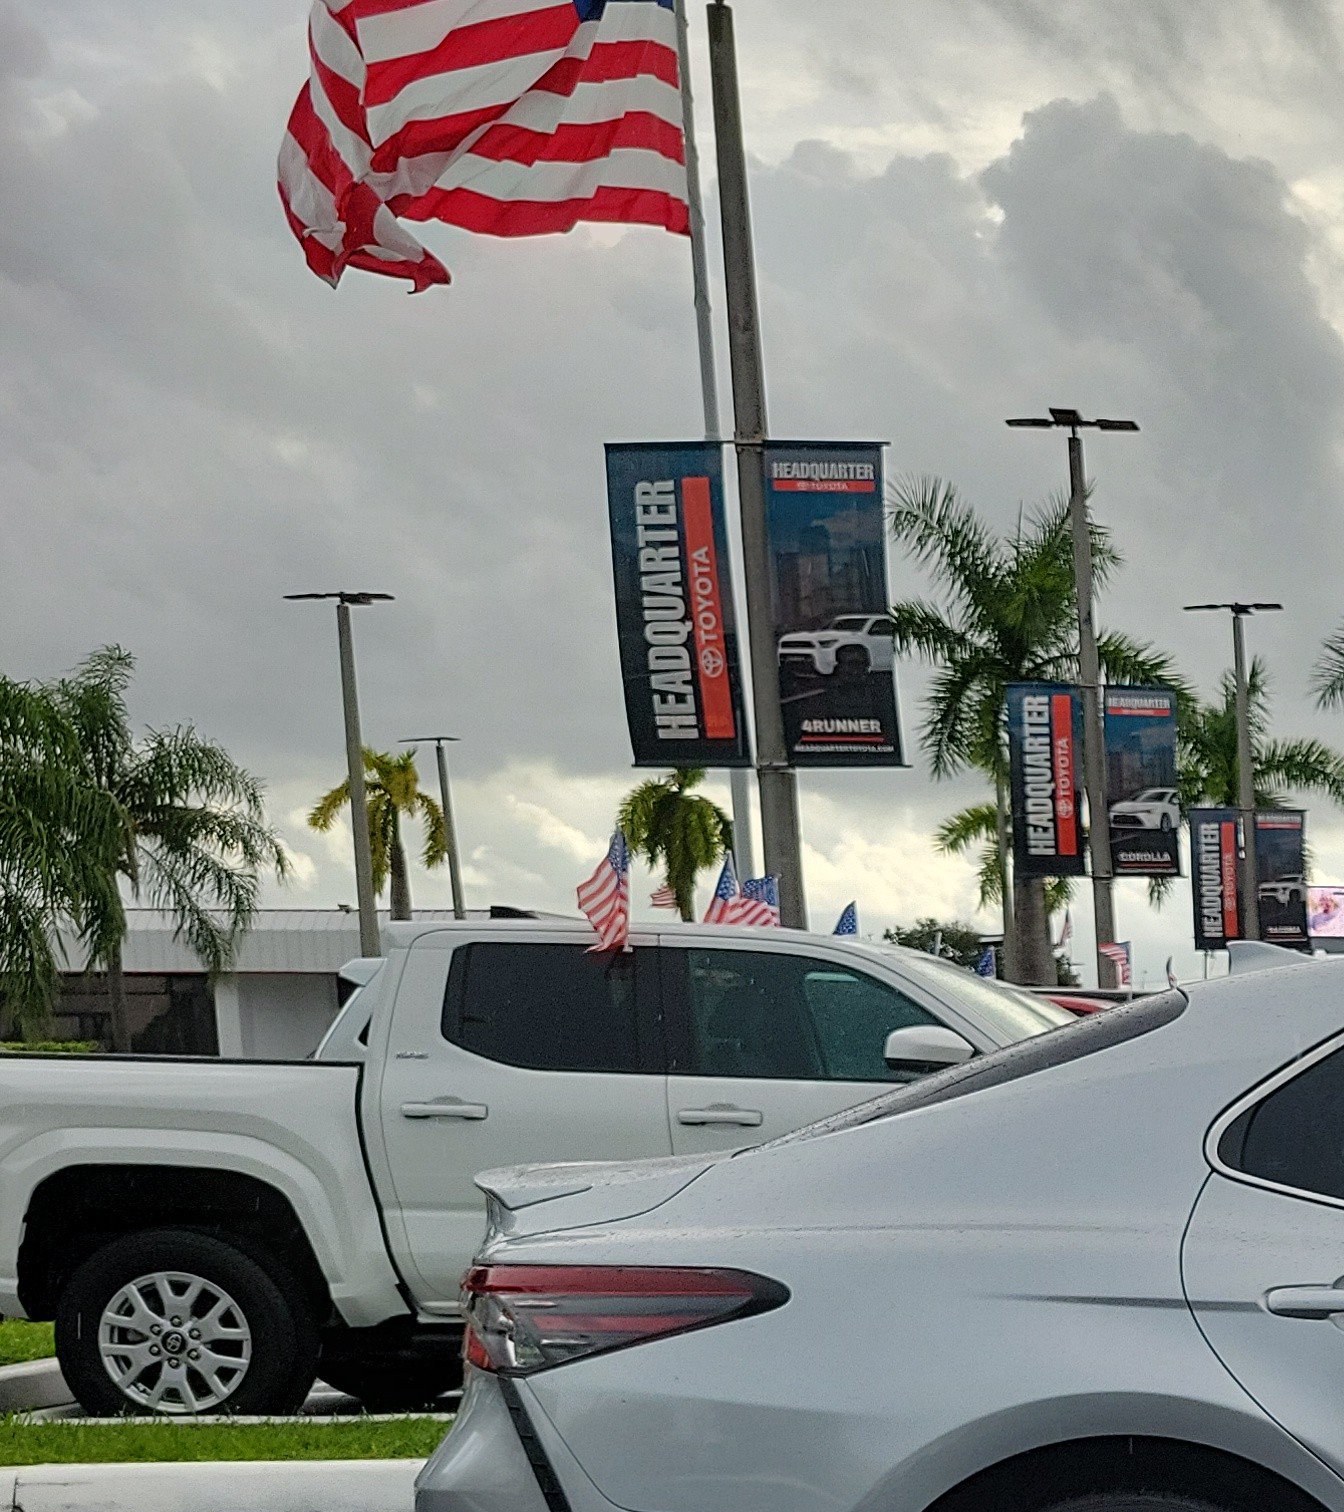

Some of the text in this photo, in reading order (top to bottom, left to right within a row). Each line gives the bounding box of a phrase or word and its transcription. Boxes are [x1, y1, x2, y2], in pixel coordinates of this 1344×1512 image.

[773, 462, 874, 480] HEADQUARTER
[635, 479, 700, 739] HEADQUARTER
[691, 546, 716, 645] TOYOTA
[801, 719, 882, 733] 4RUNNER
[1024, 695, 1056, 855] HEADQUARTER
[1057, 737, 1071, 796] TOYOTA
[1200, 823, 1223, 937] HEADQUARTER
